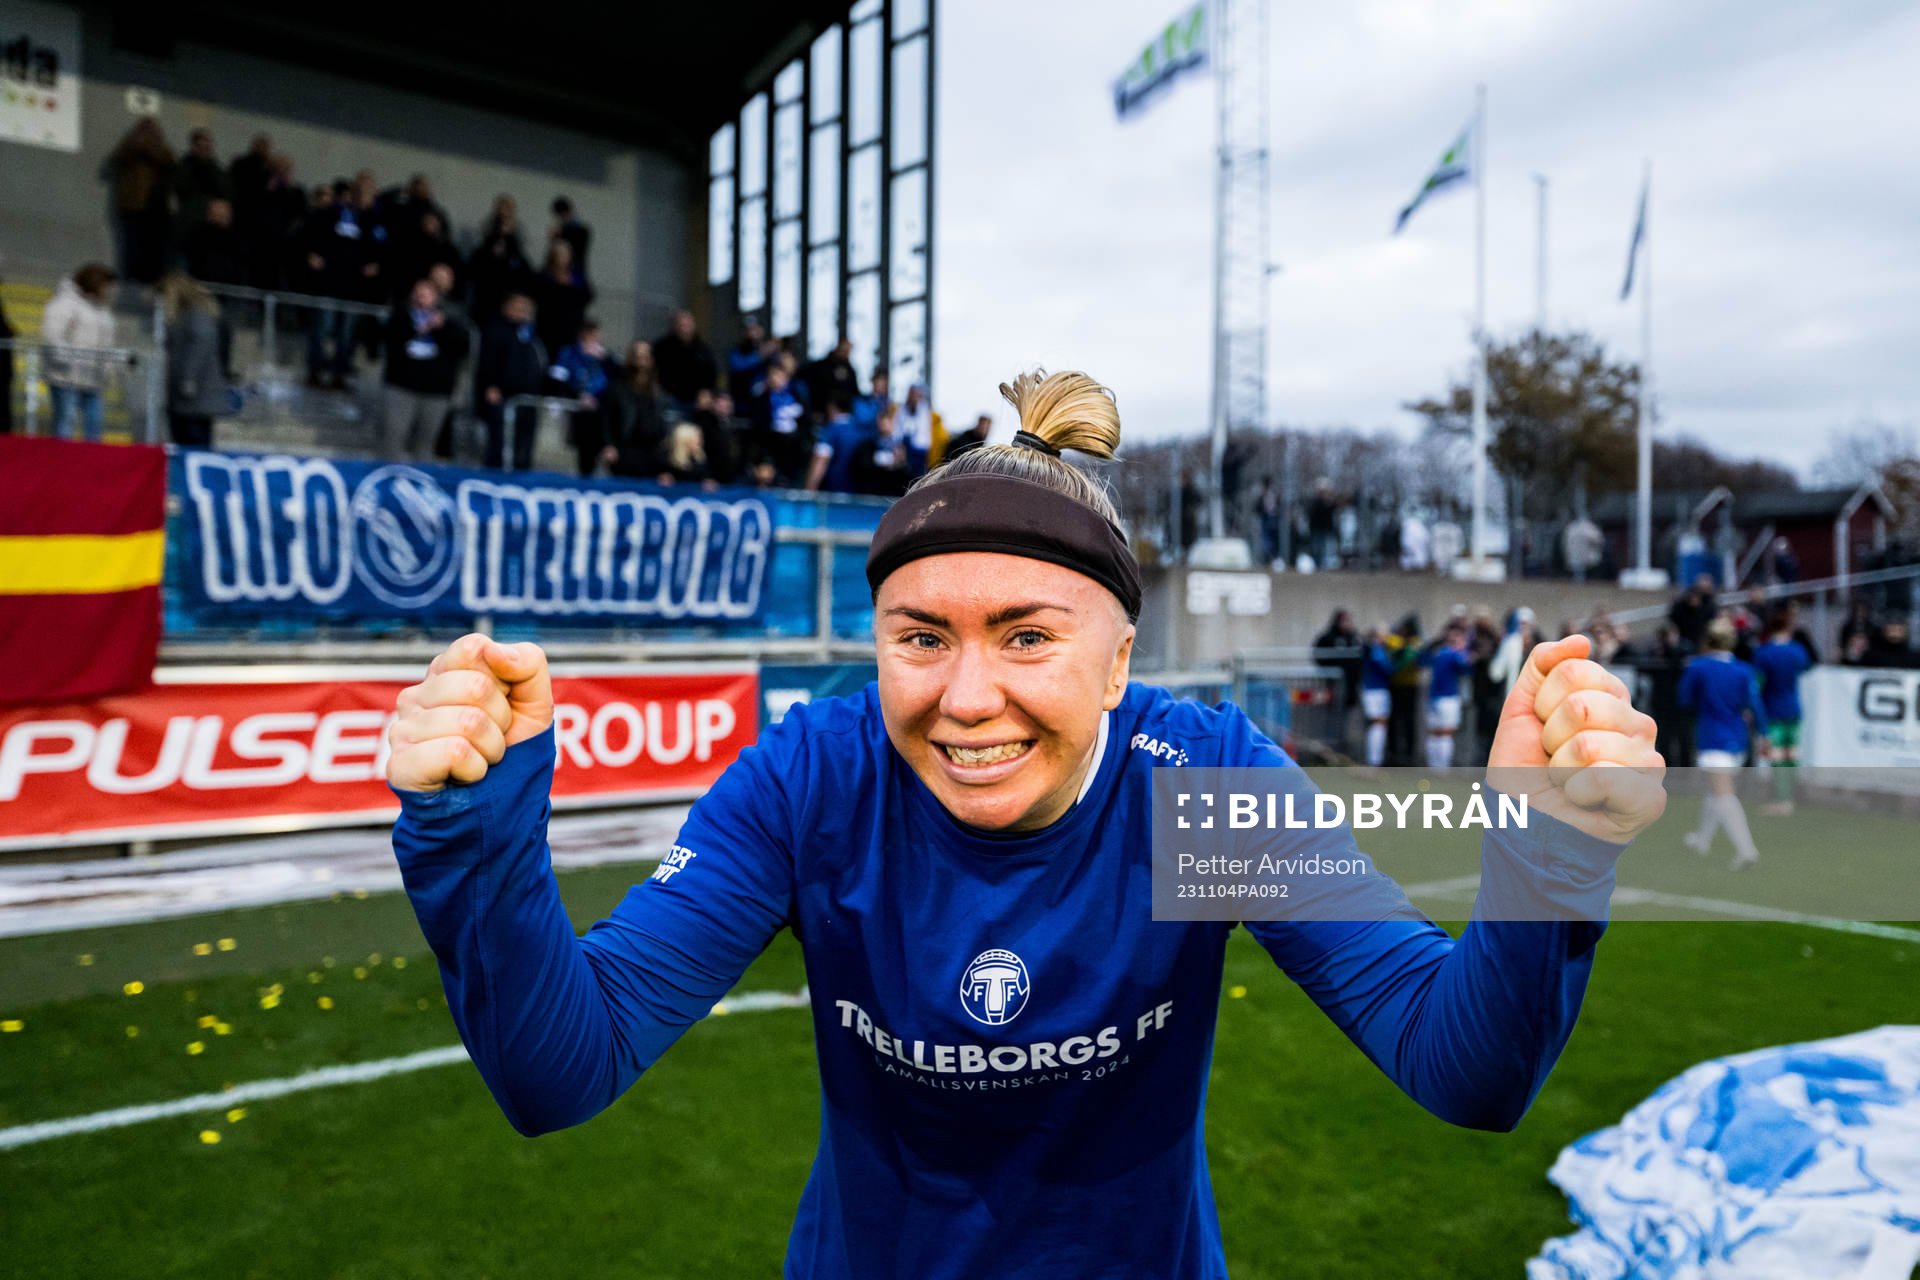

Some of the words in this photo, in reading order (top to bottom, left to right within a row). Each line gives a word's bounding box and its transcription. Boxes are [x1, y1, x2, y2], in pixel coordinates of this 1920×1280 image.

[184, 453, 352, 604] TIFO
[459, 480, 772, 619] TRELLEBORG
[0, 710, 394, 797] PULSE
[553, 698, 736, 770] ROUP
[835, 999, 1121, 1074] TRELLEBORGS
[1136, 1001, 1174, 1041] FF
[1081, 1054, 1131, 1081] 2024
